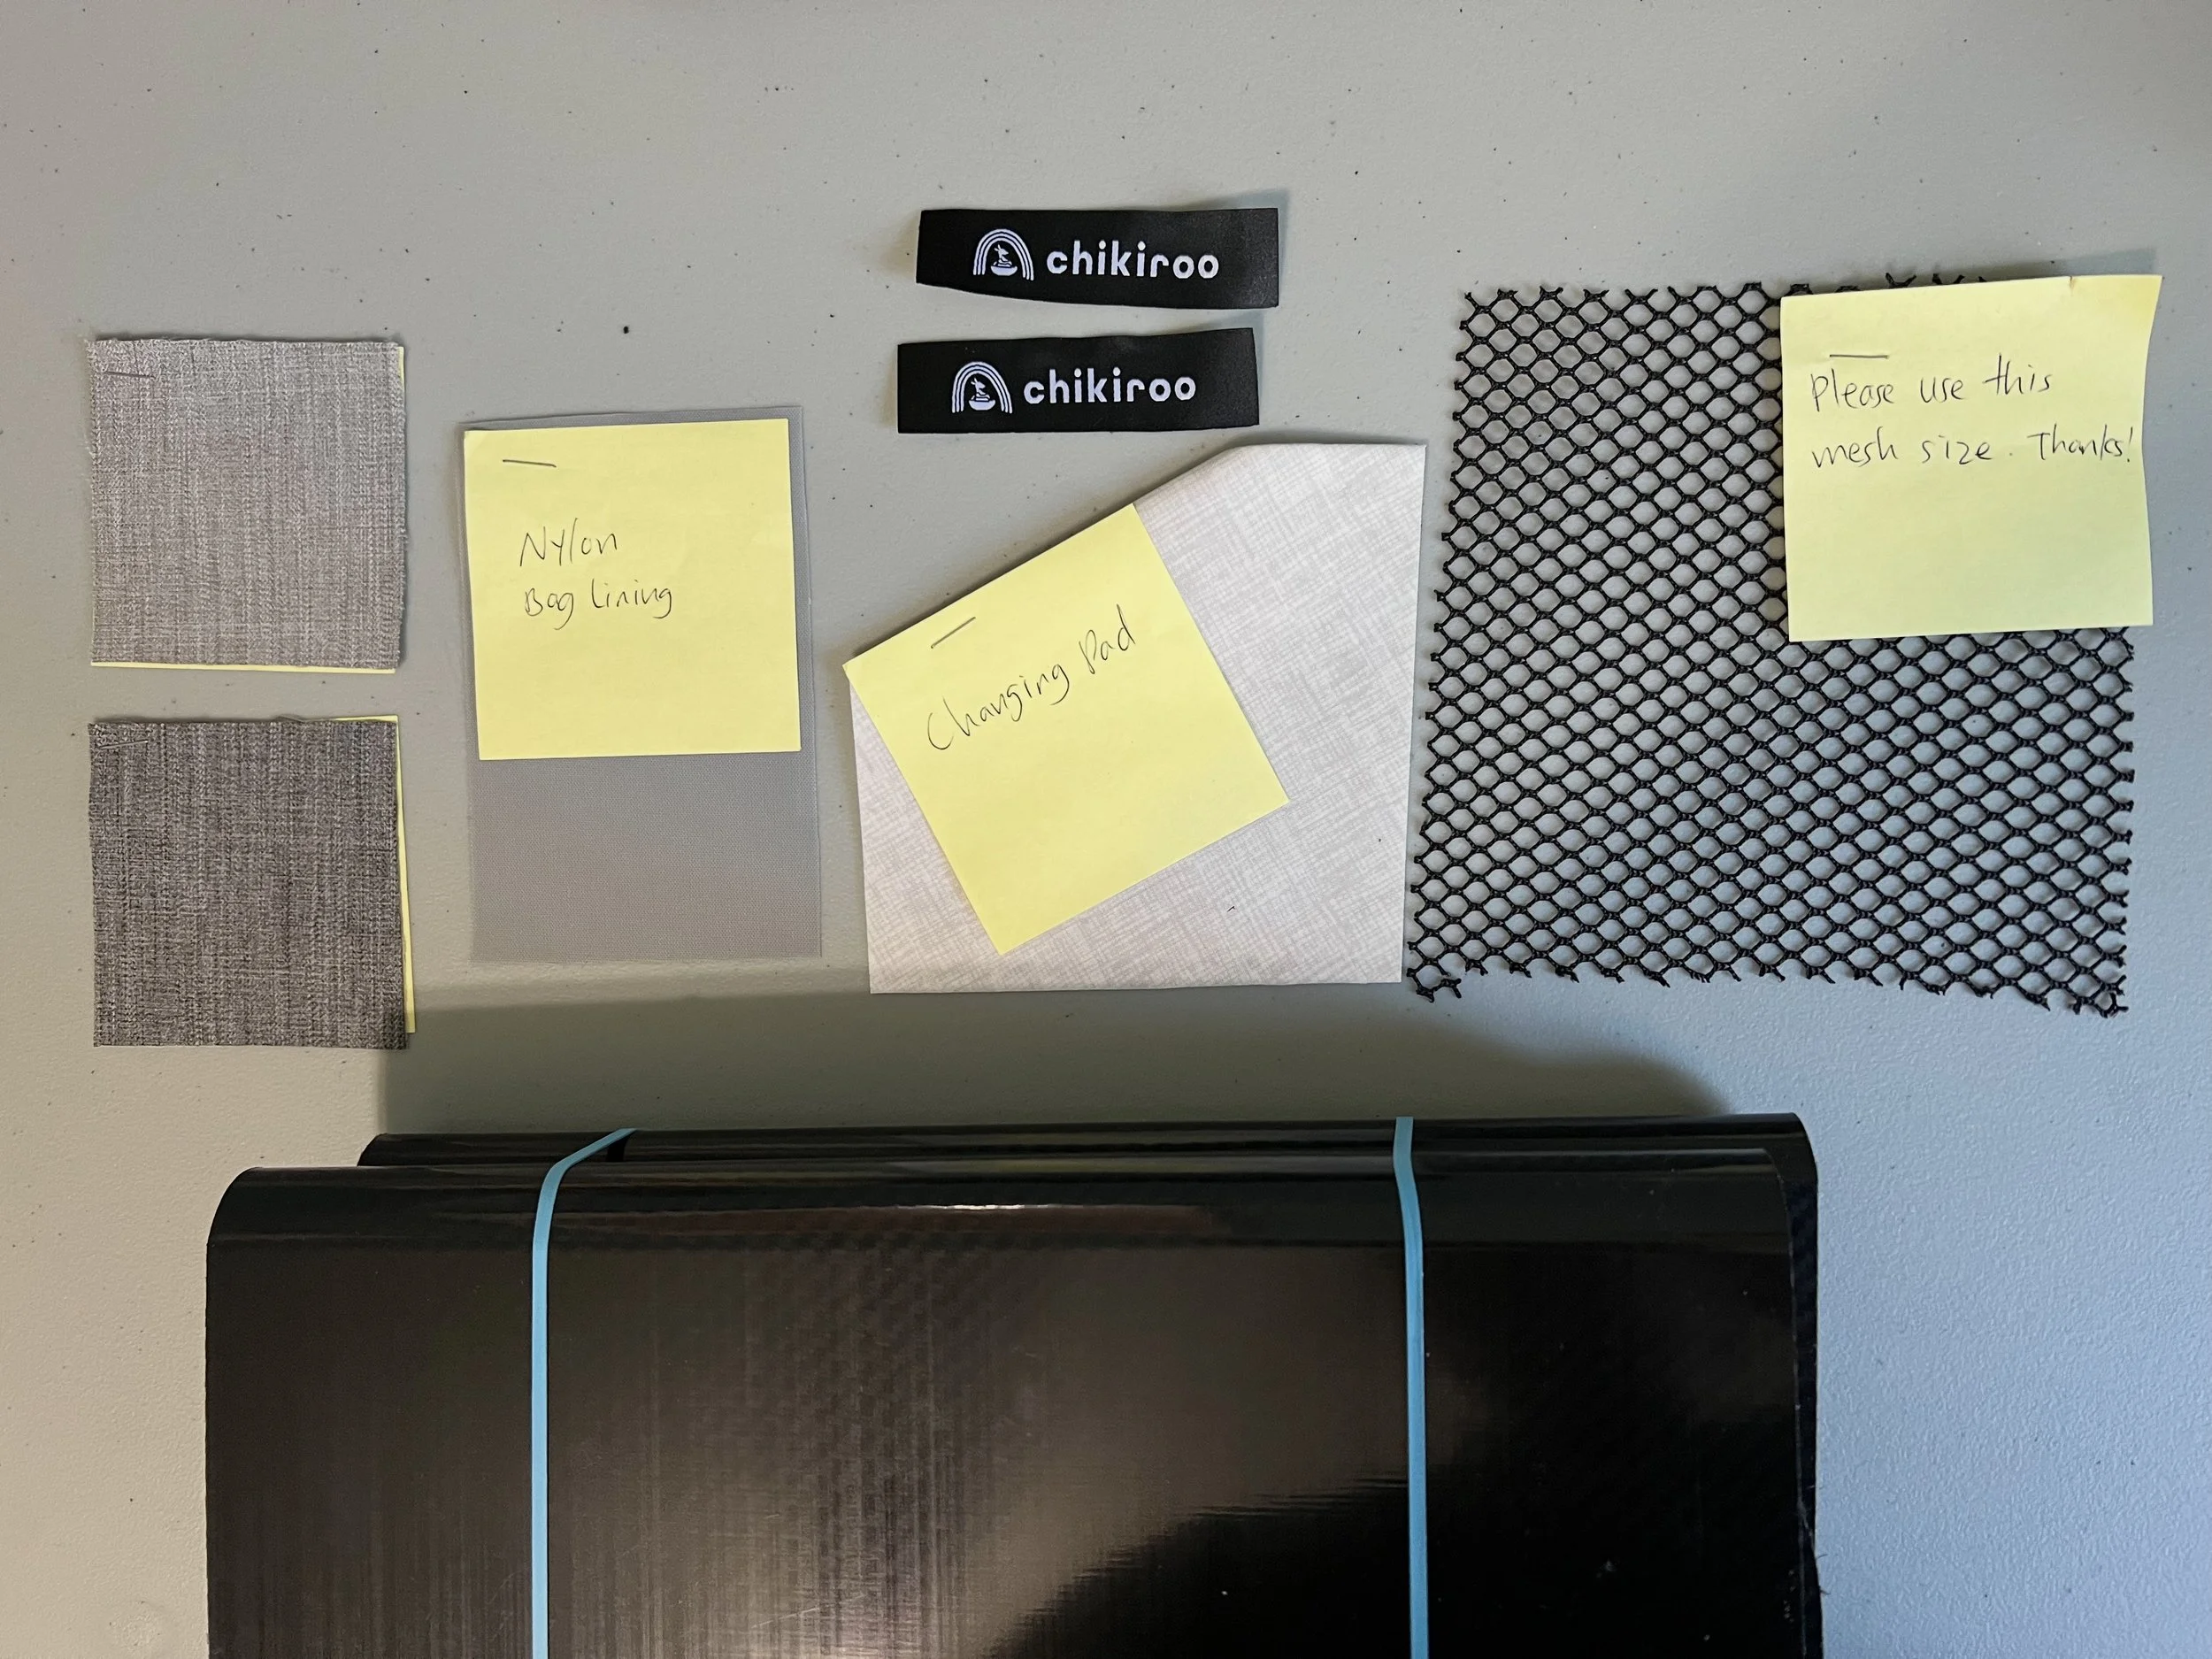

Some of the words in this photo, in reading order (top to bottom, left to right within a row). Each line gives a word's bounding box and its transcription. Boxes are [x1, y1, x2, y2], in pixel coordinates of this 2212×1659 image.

[1047, 240, 1218, 279] chikiroo
[1024, 366, 1196, 403] chikiroo
[1919, 376, 1963, 403] use
[1982, 353, 2053, 395] this
[1812, 426, 1898, 469] mesh
[2026, 423, 2133, 464] Thanks!
[524, 588, 574, 631] Bag
[926, 663, 1070, 750] Changing
[1078, 603, 1135, 675] Pad
